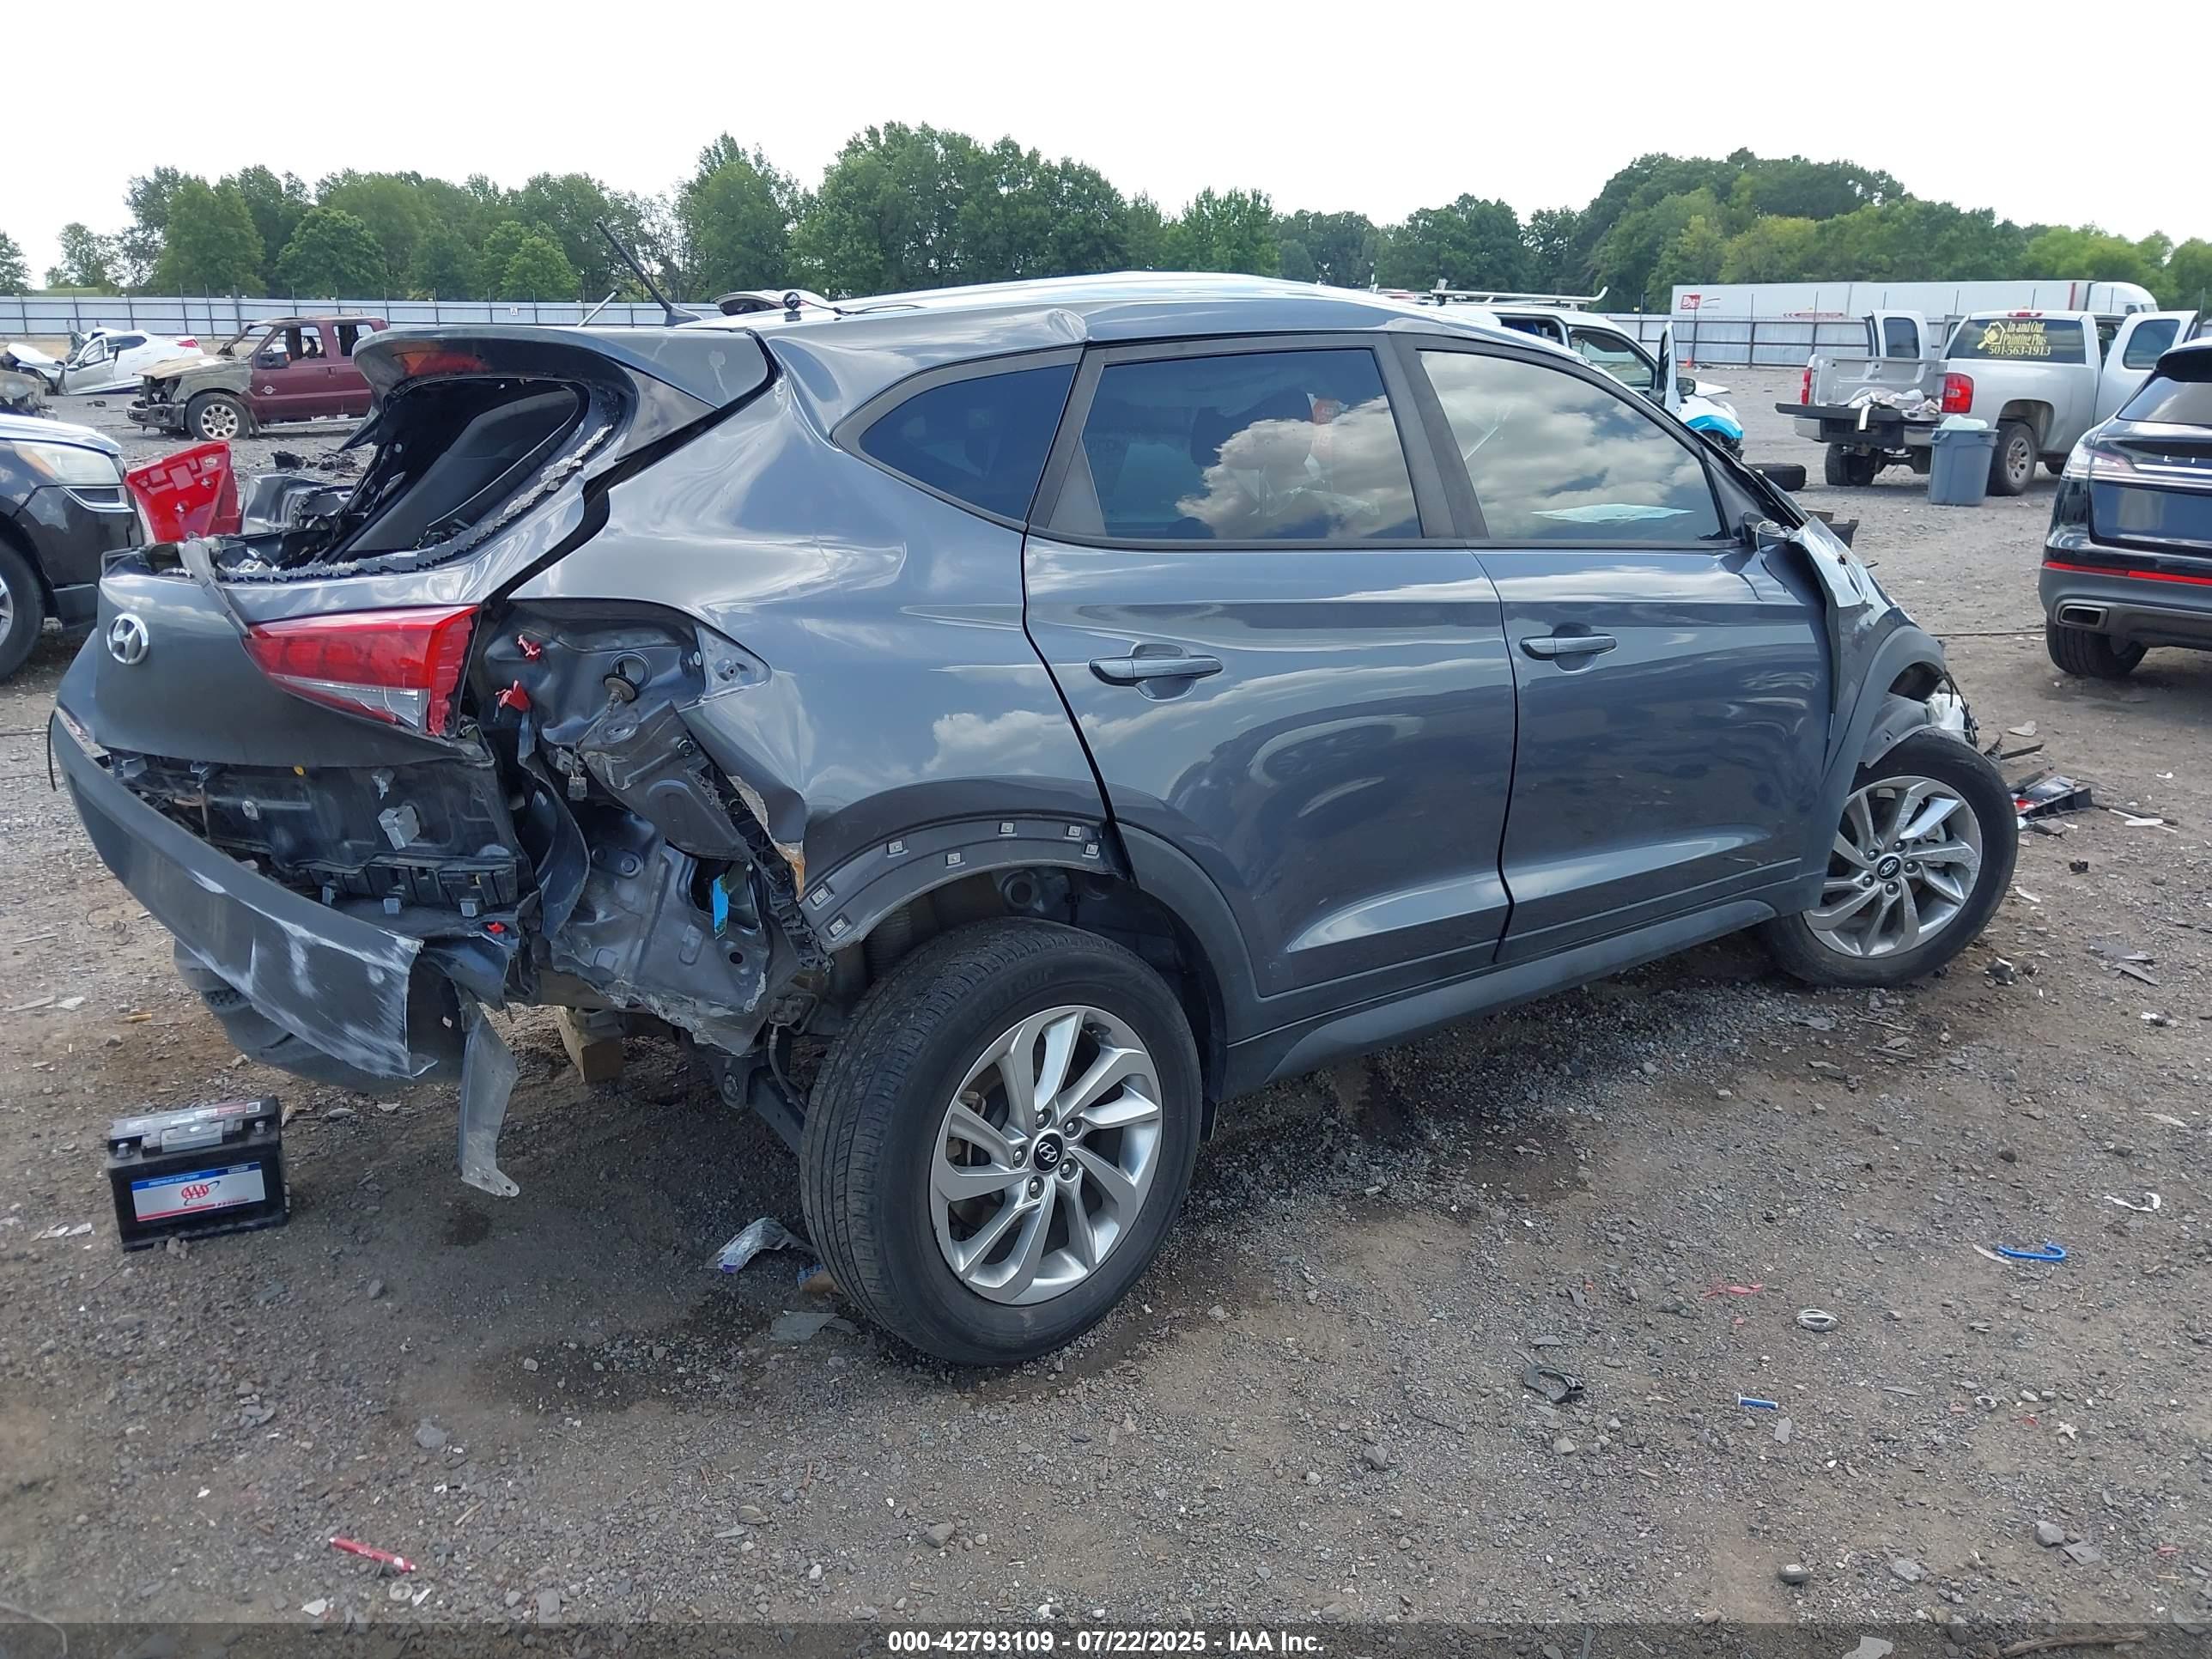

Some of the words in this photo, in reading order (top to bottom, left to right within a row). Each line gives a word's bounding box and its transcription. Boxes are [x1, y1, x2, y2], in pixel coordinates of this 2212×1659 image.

[2007, 321, 2016, 332] In
[2016, 321, 2032, 332] and
[2031, 321, 2045, 333] Out
[2002, 334, 2032, 345] Painting
[2032, 334, 2048, 345] Plus
[1988, 345, 2051, 356] 501-563-1913
[183, 1184, 208, 1199] AAA
